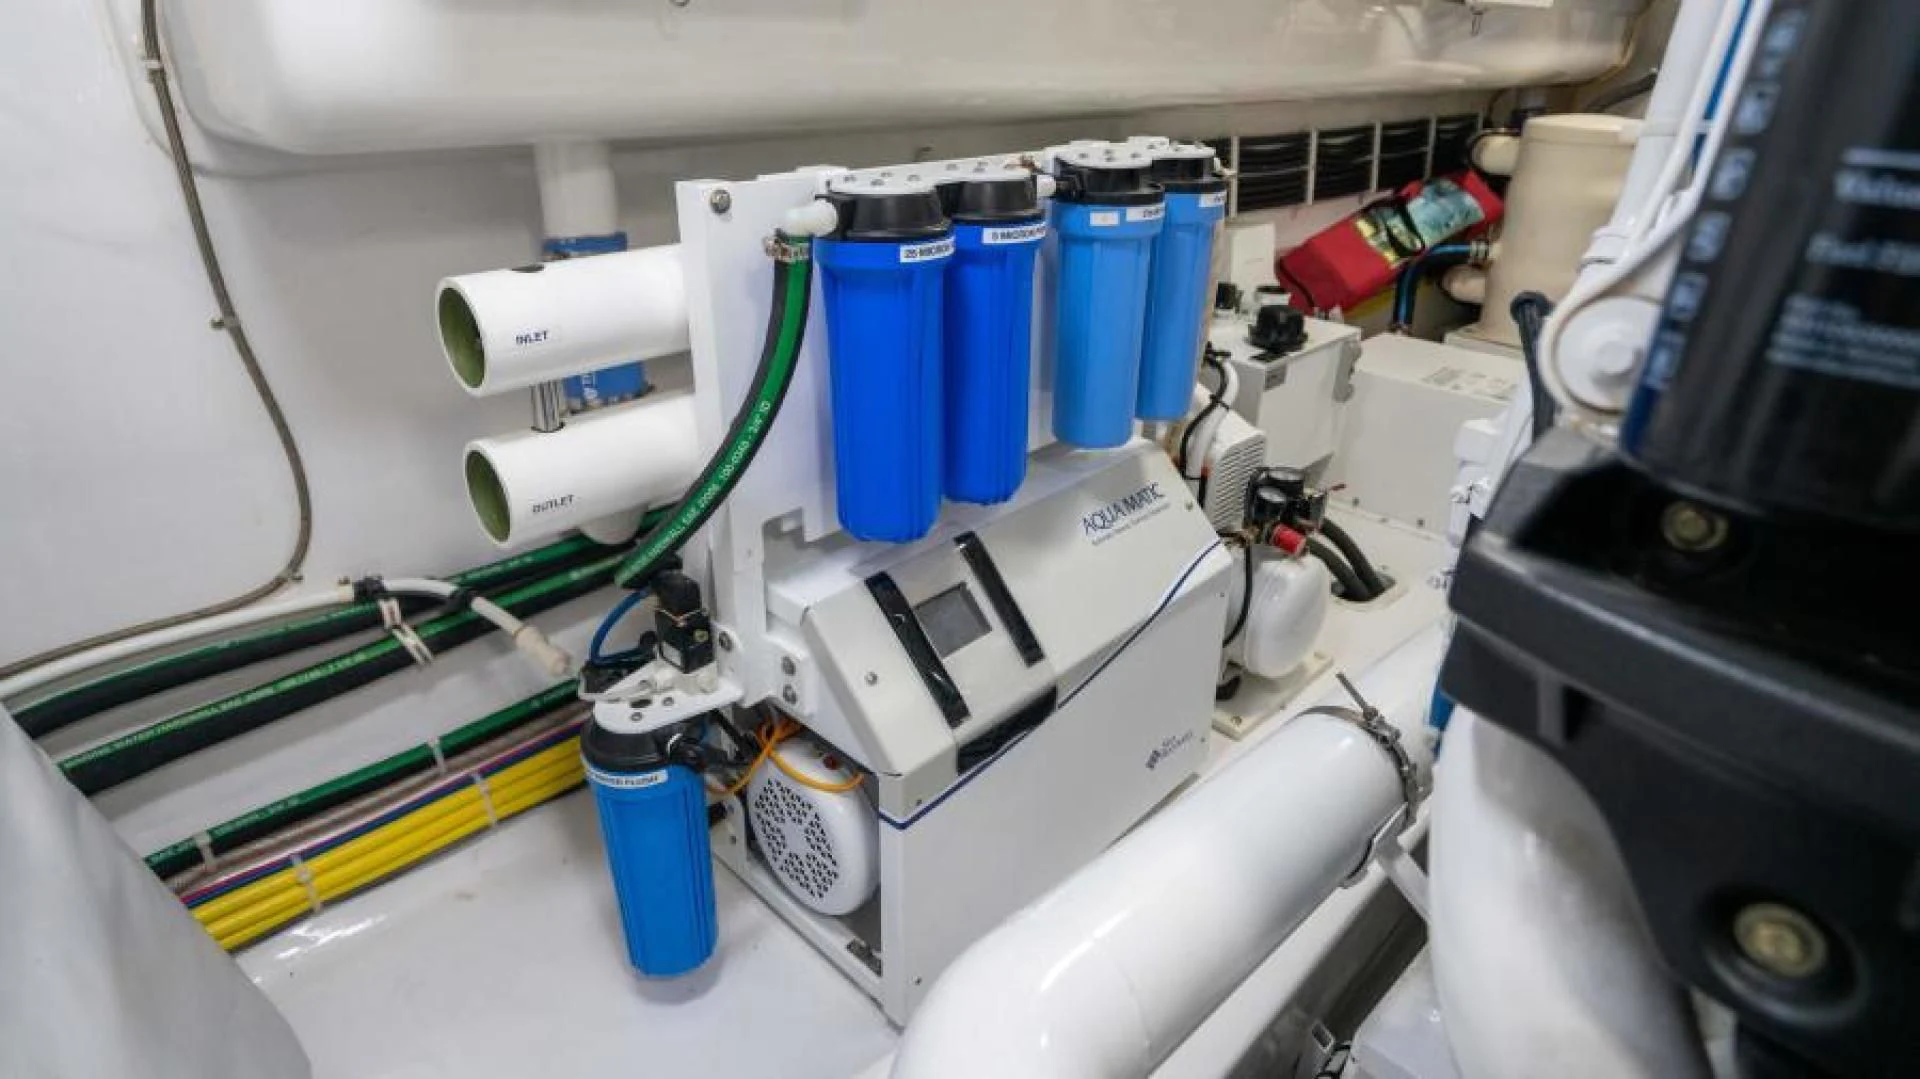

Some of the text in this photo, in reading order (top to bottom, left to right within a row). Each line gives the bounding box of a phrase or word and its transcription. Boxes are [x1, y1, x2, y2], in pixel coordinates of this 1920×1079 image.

[515, 330, 549, 346] INLET
[532, 494, 575, 513] OUTLET
[1083, 501, 1127, 536] AQUA
[1121, 482, 1165, 514] MATIC
